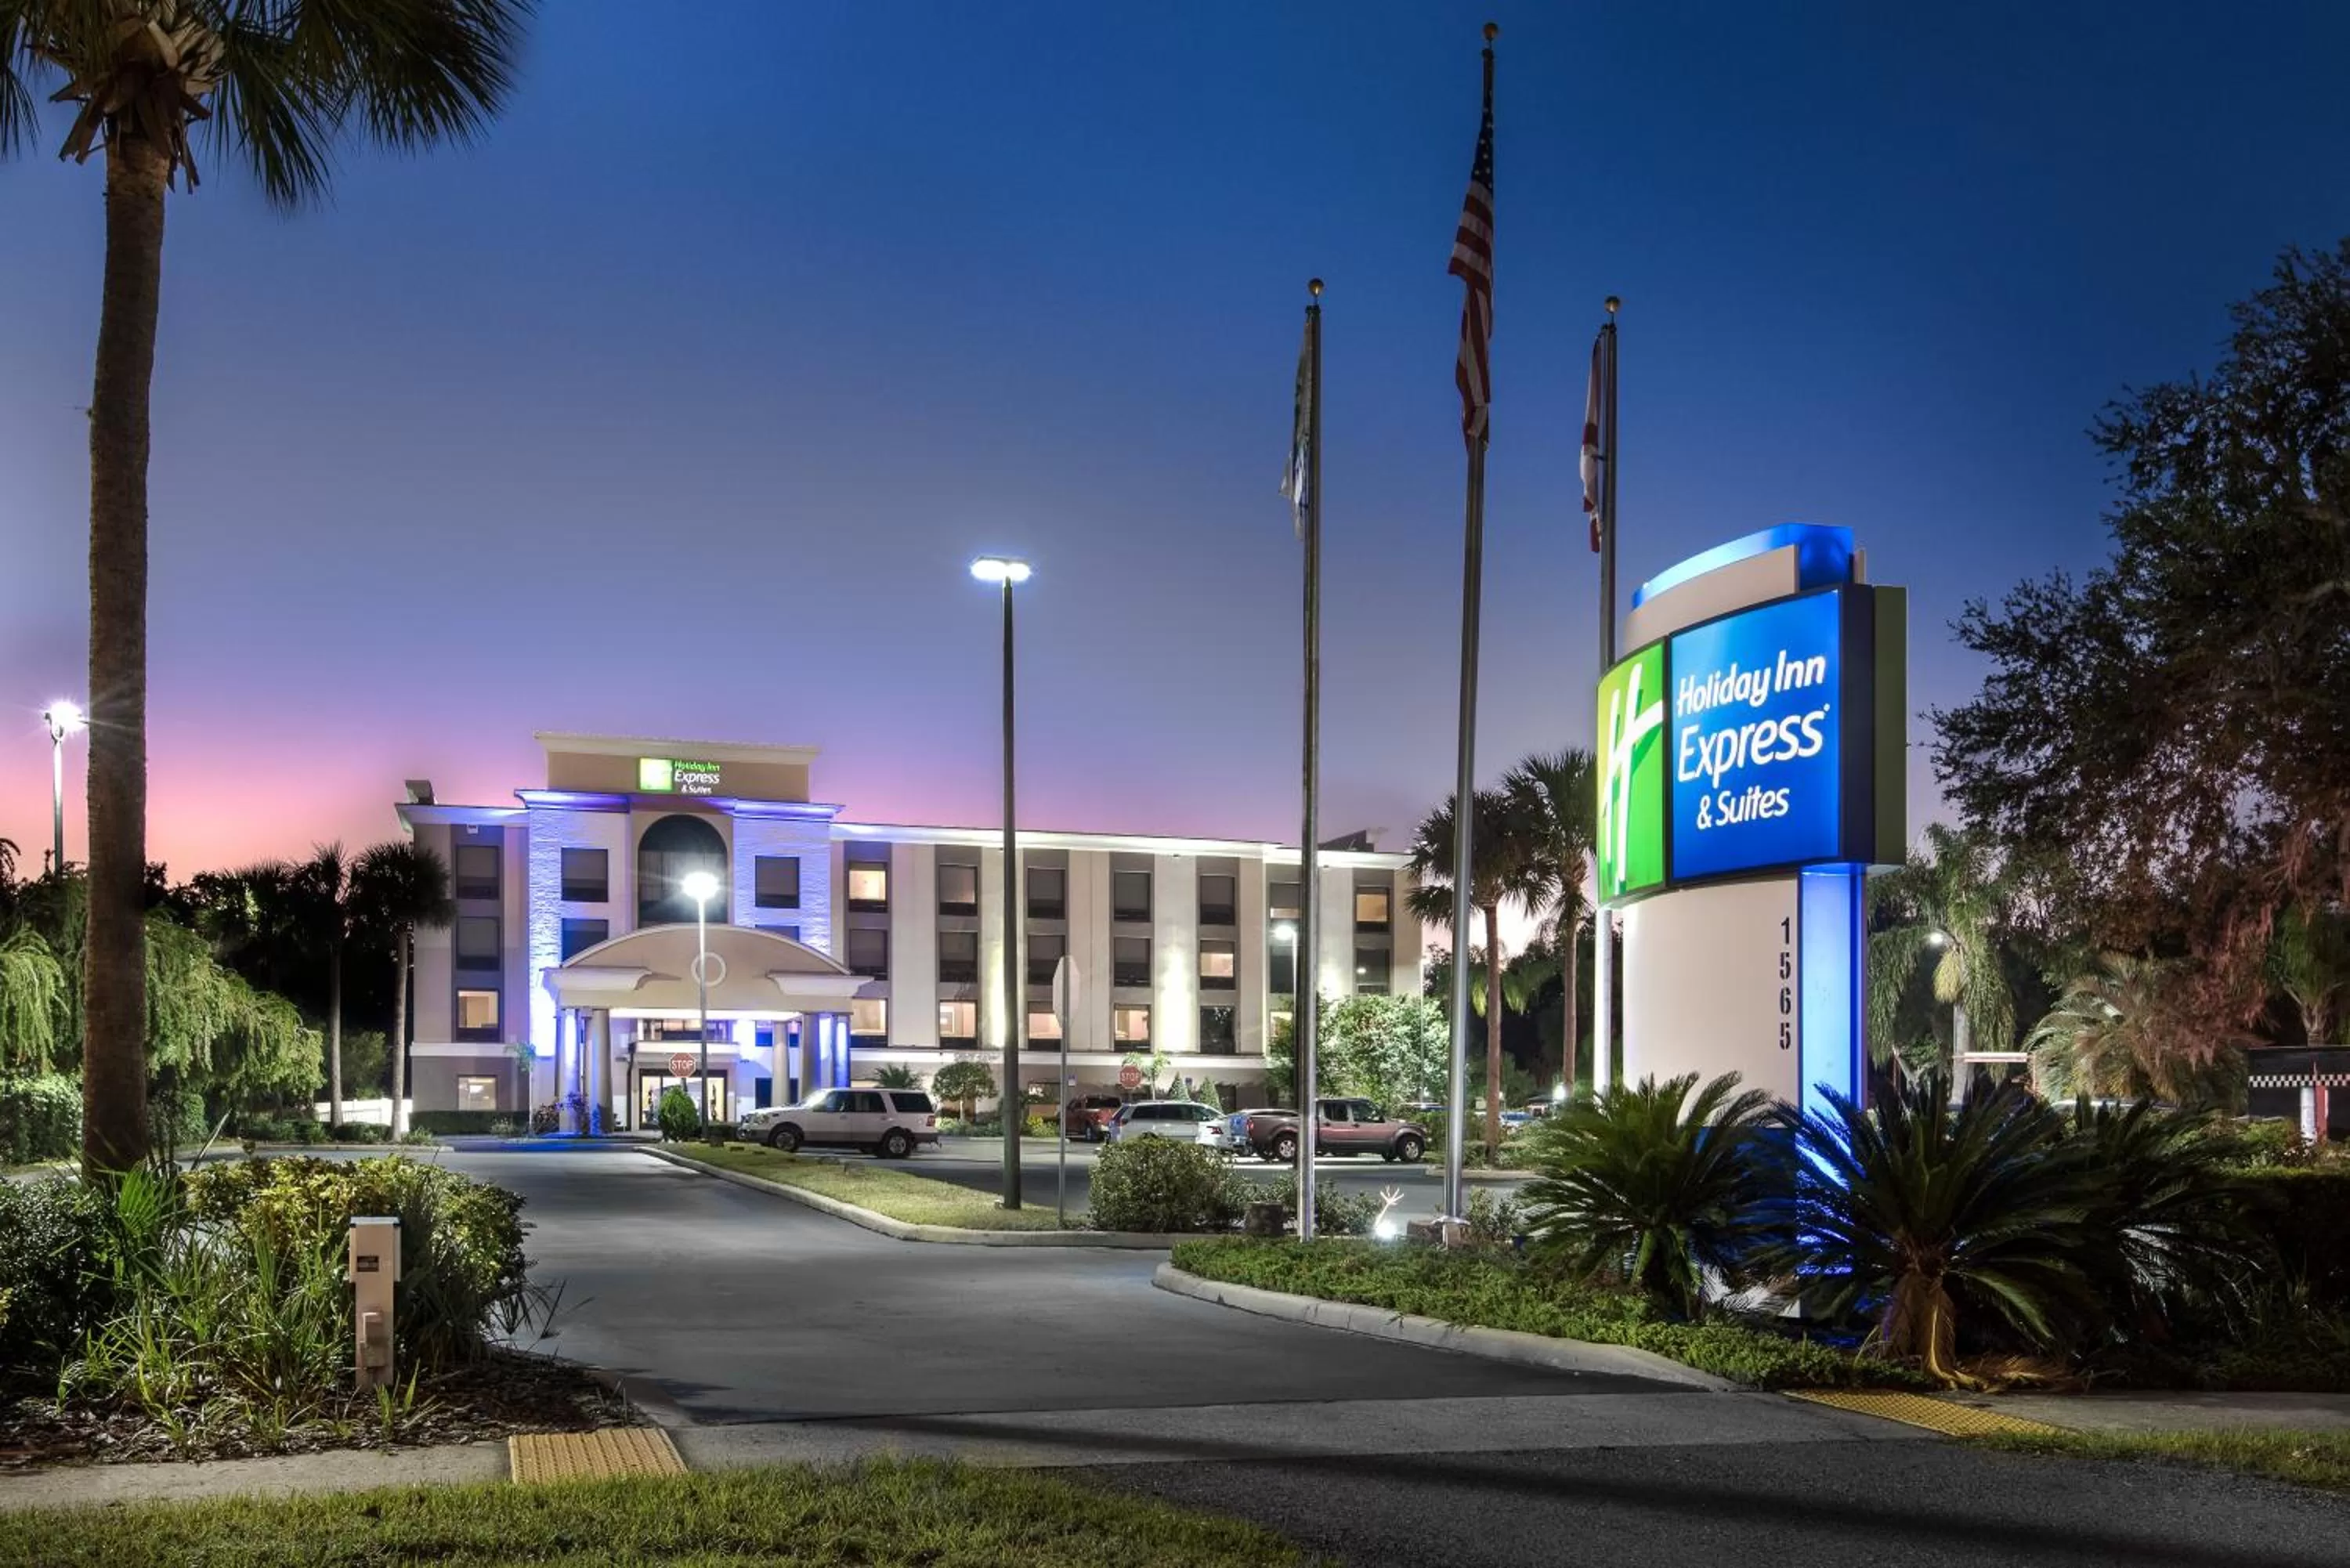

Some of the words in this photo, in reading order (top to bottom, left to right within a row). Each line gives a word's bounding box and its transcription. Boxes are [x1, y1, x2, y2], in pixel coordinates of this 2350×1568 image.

[1676, 661, 1771, 716] Holiday
[1775, 650, 1826, 692] Inn
[1677, 709, 1824, 789] Express
[674, 761, 706, 772] Holiday
[706, 762, 720, 771] Inn
[674, 770, 720, 784] Express
[681, 785, 688, 793] &
[689, 785, 712, 794] Suites
[1697, 795, 1712, 830] &
[1716, 785, 1790, 827] Suites
[671, 1060, 693, 1070] STOP
[1121, 1072, 1139, 1082] STOP
